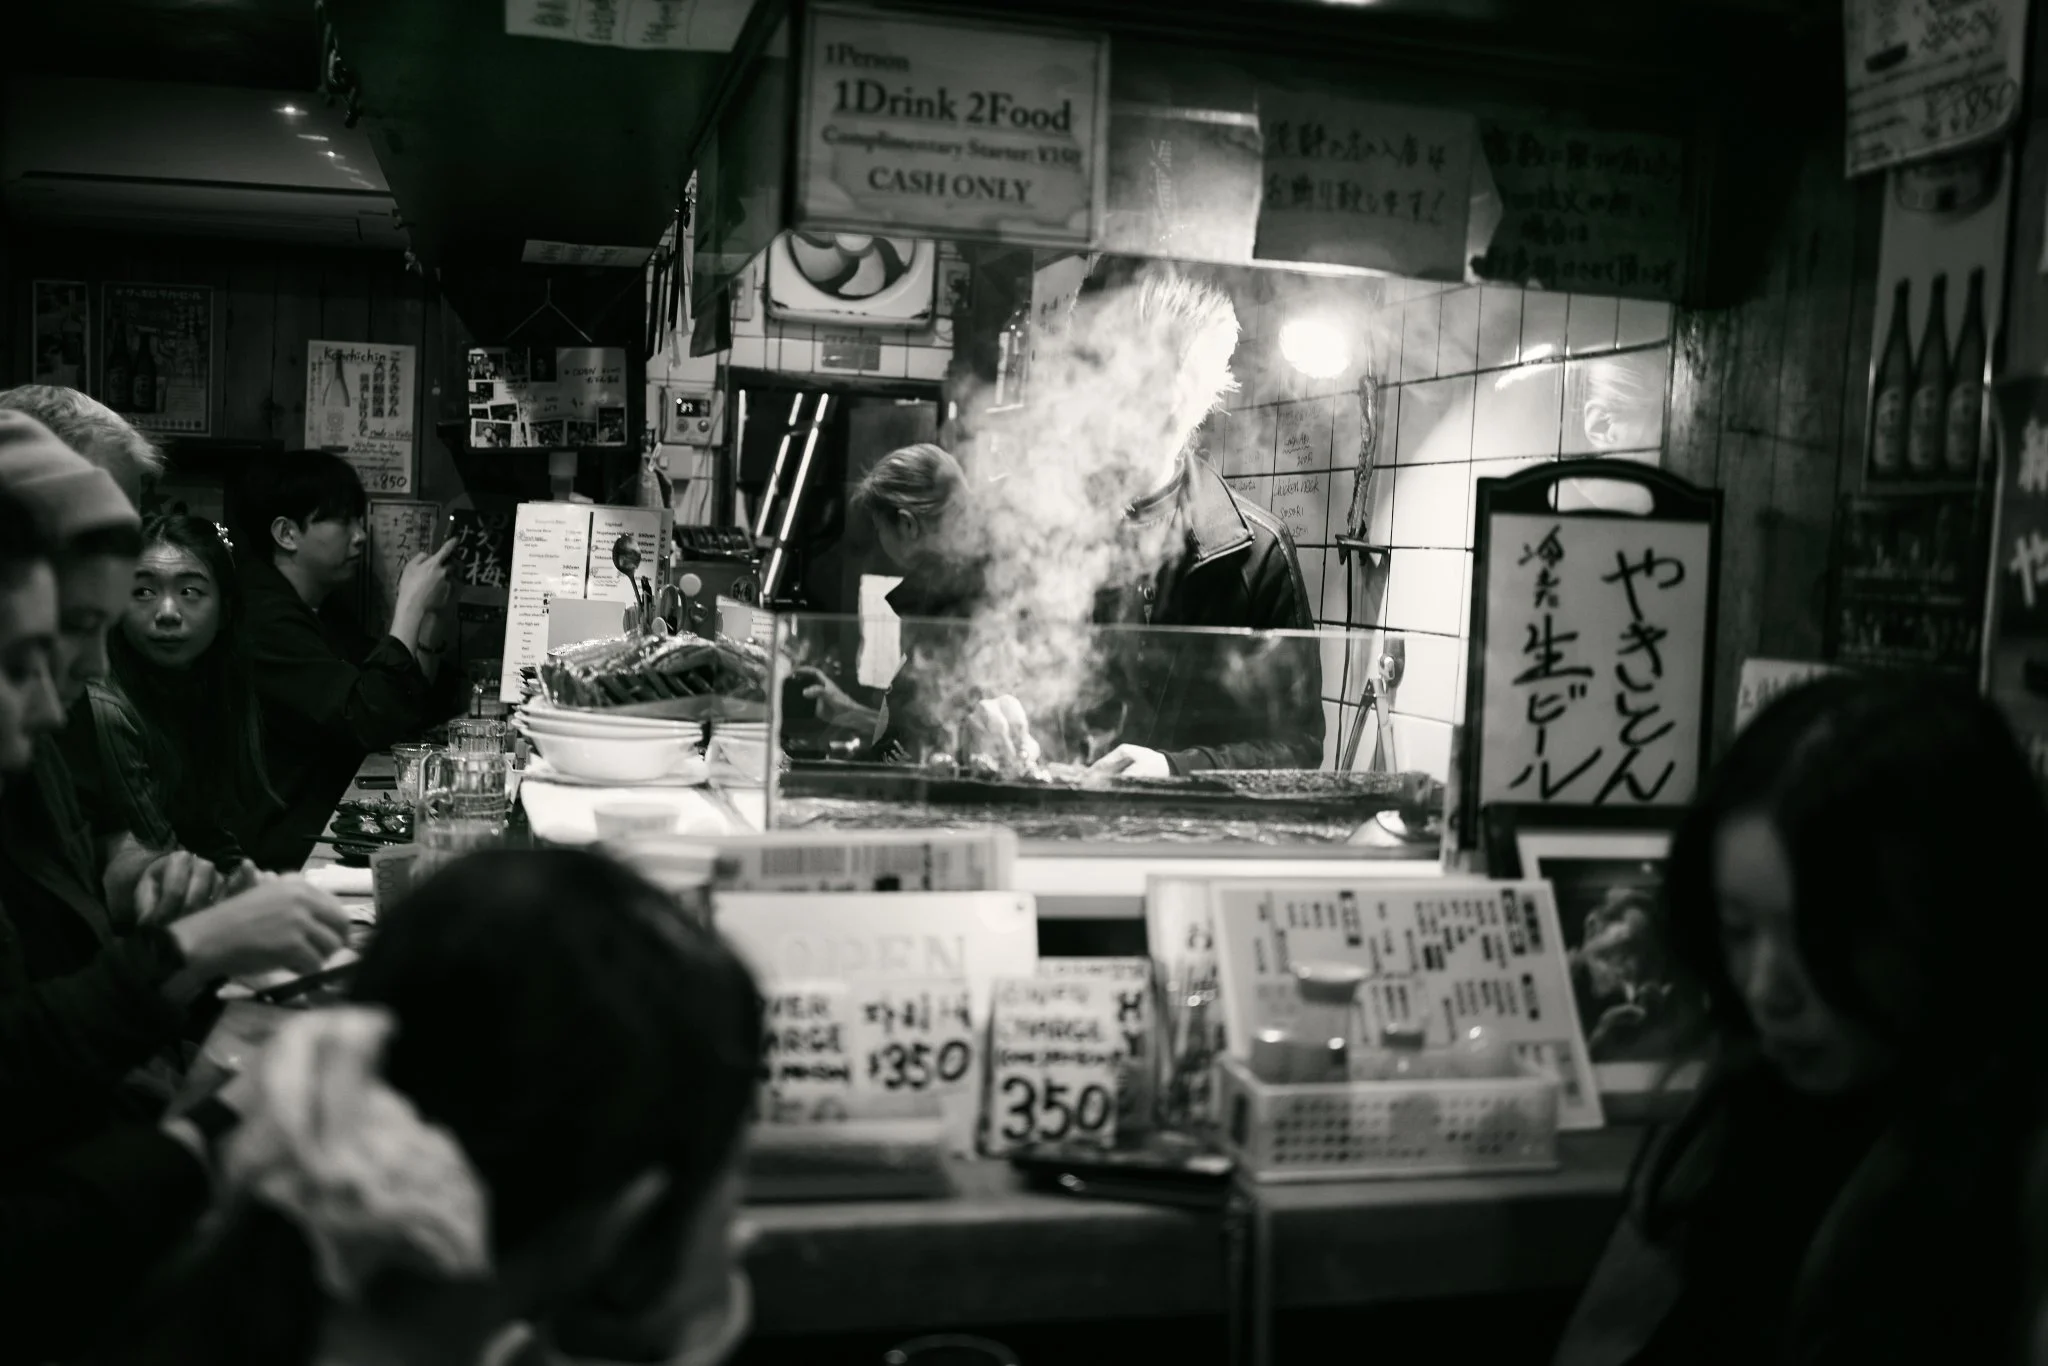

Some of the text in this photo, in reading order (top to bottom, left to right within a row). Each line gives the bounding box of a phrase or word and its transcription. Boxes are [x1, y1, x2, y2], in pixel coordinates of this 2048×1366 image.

[835, 78, 1072, 133] 1Drink 2Food
[868, 166, 1034, 204] CASH ONLY
[1594, 547, 1686, 805] やきとん
[1002, 1075, 1111, 1141] 350
